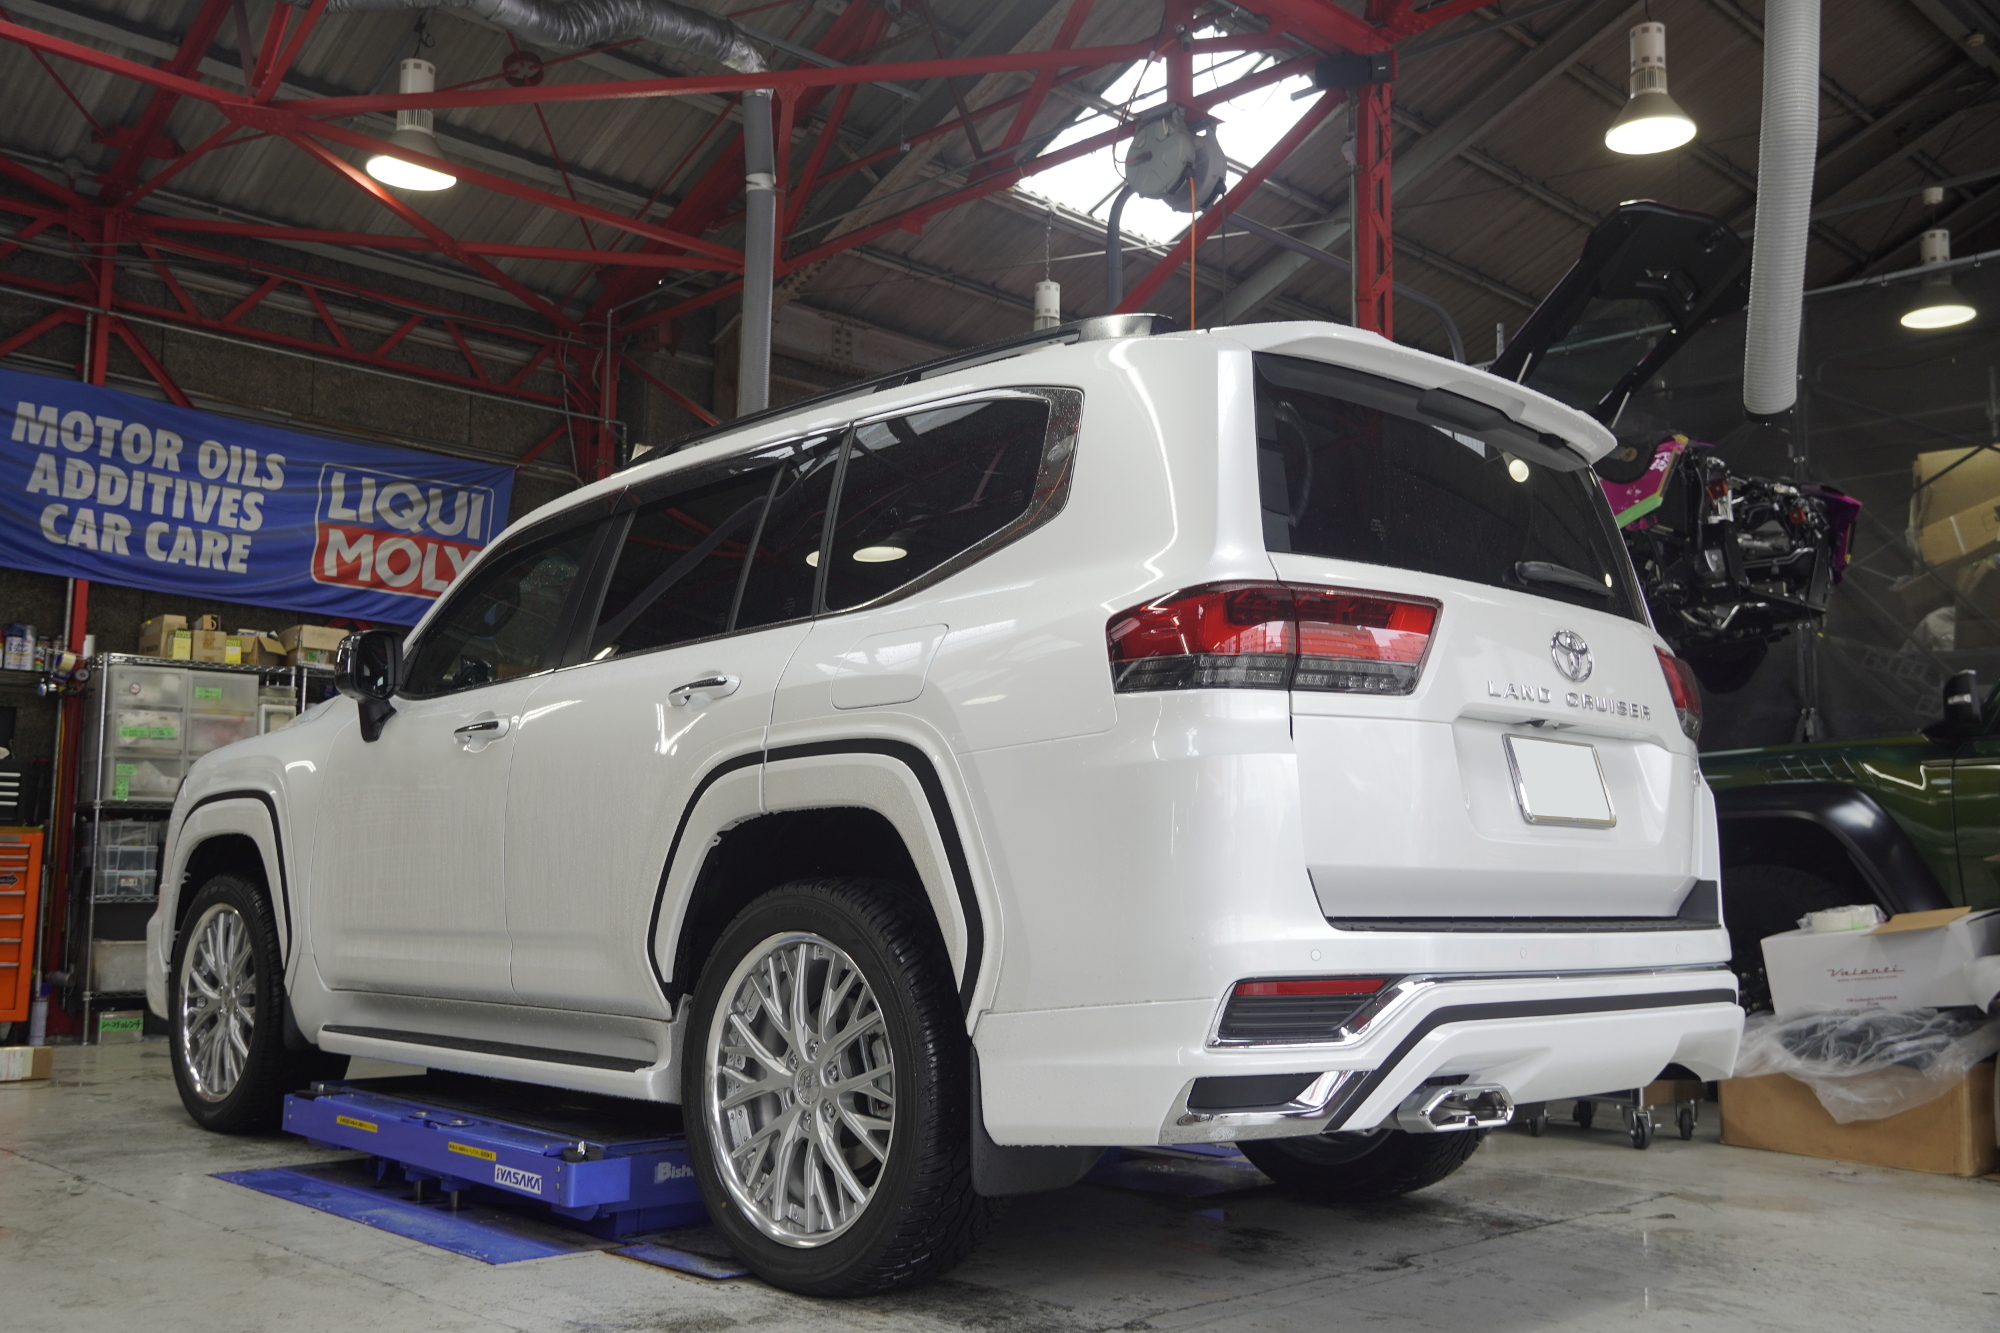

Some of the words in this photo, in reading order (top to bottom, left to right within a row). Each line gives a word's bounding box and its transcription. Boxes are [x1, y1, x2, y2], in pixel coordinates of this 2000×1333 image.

[11, 401, 184, 472] MOTOR
[198, 440, 286, 490] OILS
[26, 452, 265, 532] ADDITIVES
[328, 471, 485, 541] LIQUI
[40, 503, 130, 556] CAR
[145, 521, 251, 574] CARE
[324, 528, 481, 593] MOLY
[1487, 679, 1551, 703] LAND
[1566, 691, 1651, 721] CRUISER
[1827, 964, 1905, 977] Valenti
[653, 1161, 695, 1185] Bish
